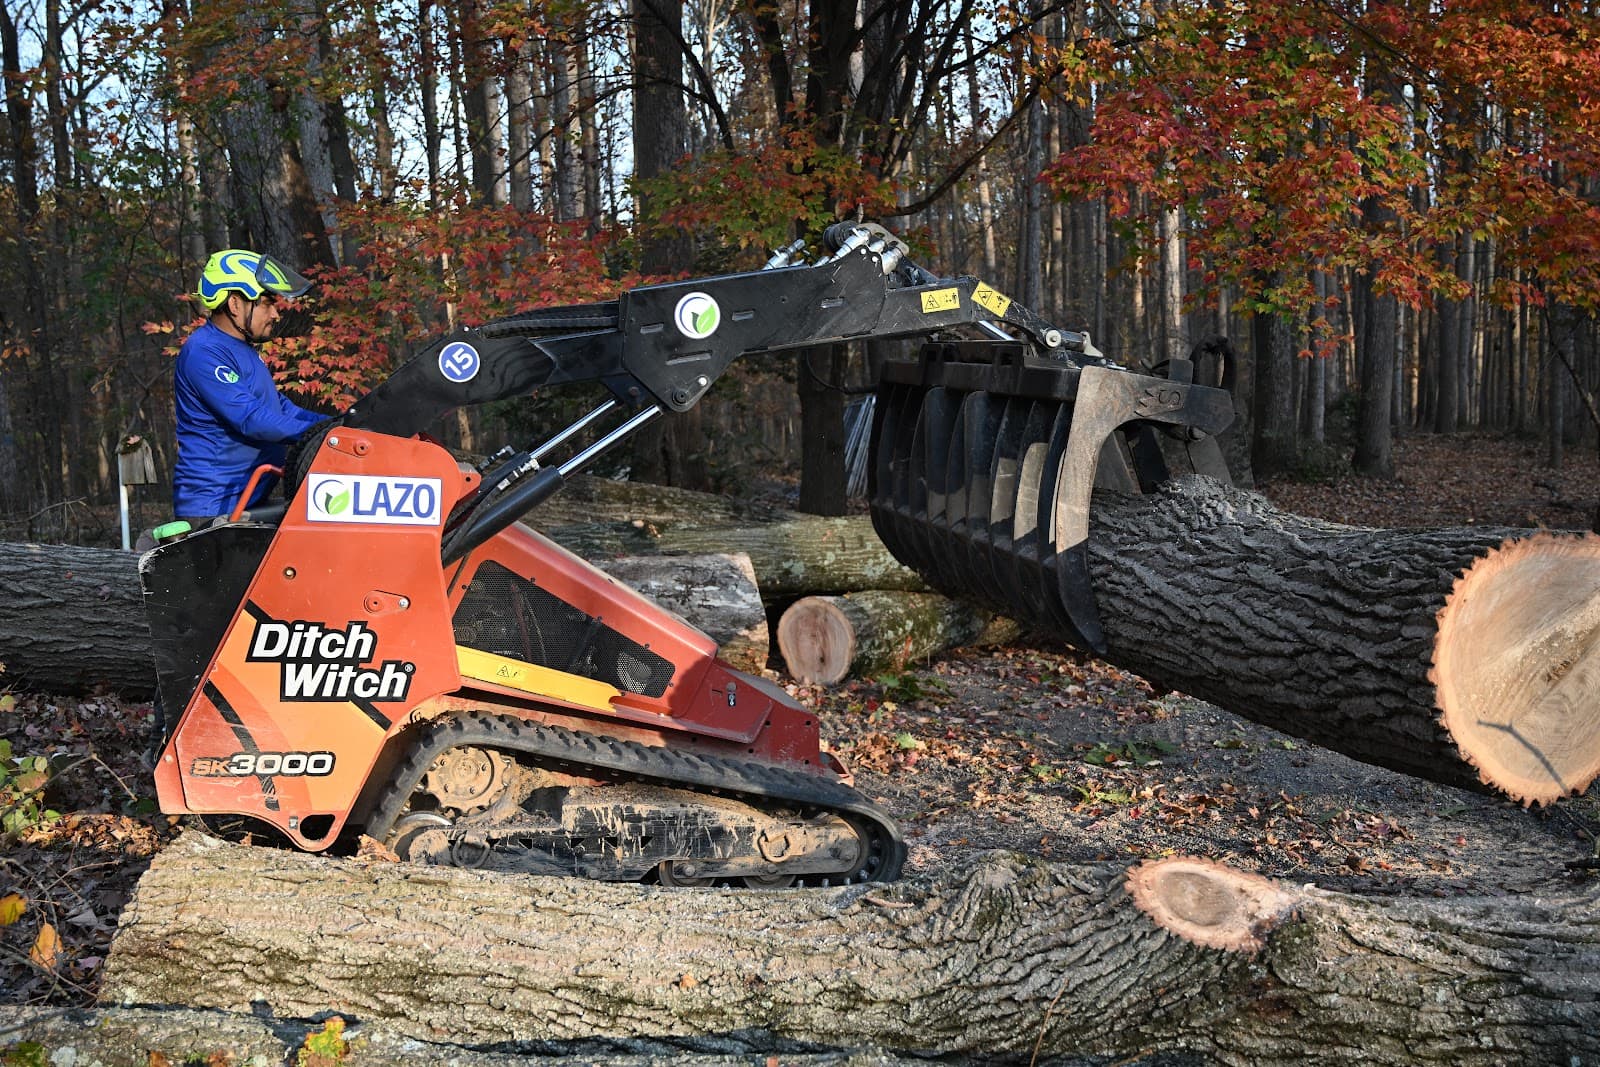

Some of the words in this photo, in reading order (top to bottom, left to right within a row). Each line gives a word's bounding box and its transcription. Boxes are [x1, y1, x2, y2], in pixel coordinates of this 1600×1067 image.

[445, 347, 473, 376] 15
[353, 481, 435, 518] LAZO
[252, 623, 374, 659] Ditch
[192, 754, 333, 776] SK3000
